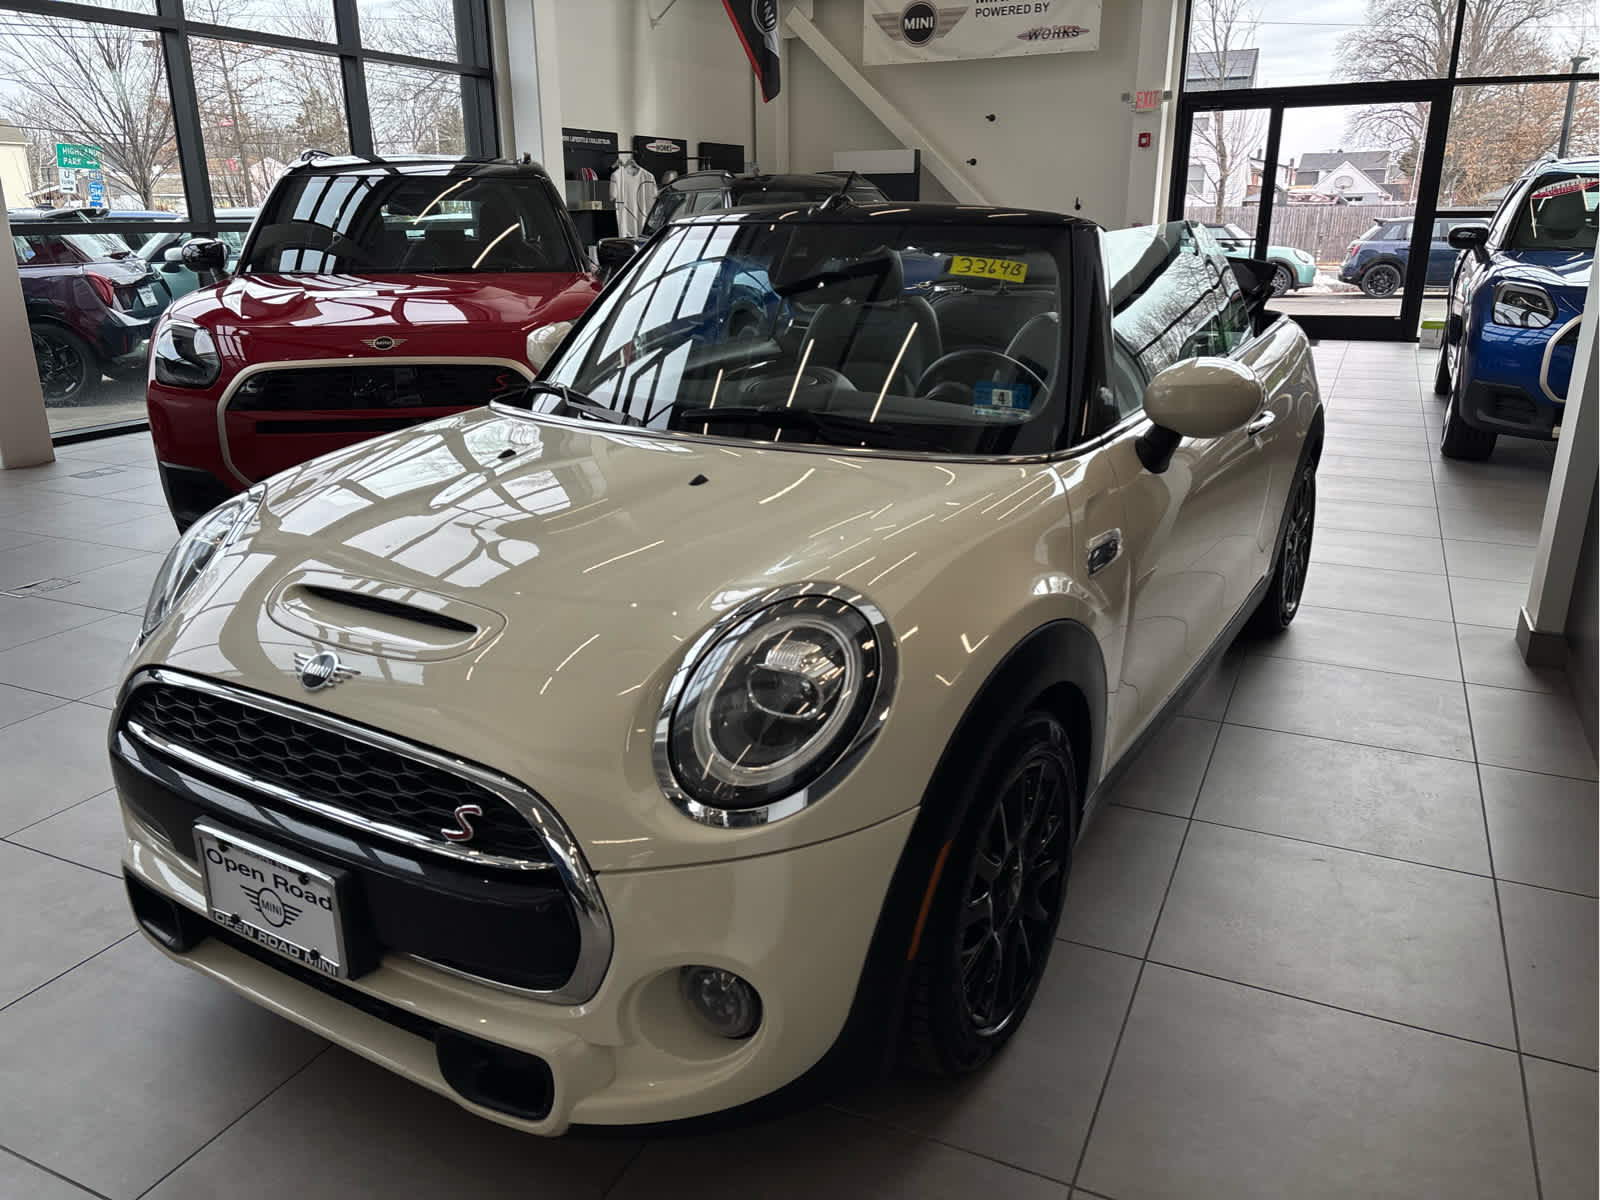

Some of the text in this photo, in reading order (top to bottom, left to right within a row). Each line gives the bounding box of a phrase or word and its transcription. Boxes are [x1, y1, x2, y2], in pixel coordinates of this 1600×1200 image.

[975, 3, 1050, 18] POWERED BY
[904, 16, 933, 30] MINI
[1027, 26, 1081, 41] WORKS
[1136, 90, 1160, 109] EXIT
[64, 170, 70, 178] U
[304, 662, 332, 679] MINI
[441, 805, 483, 841] S
[207, 848, 265, 883] Open
[273, 875, 333, 911] Road
[261, 898, 283, 917] MINI
[215, 912, 337, 977] OPEN ROAD MINI
